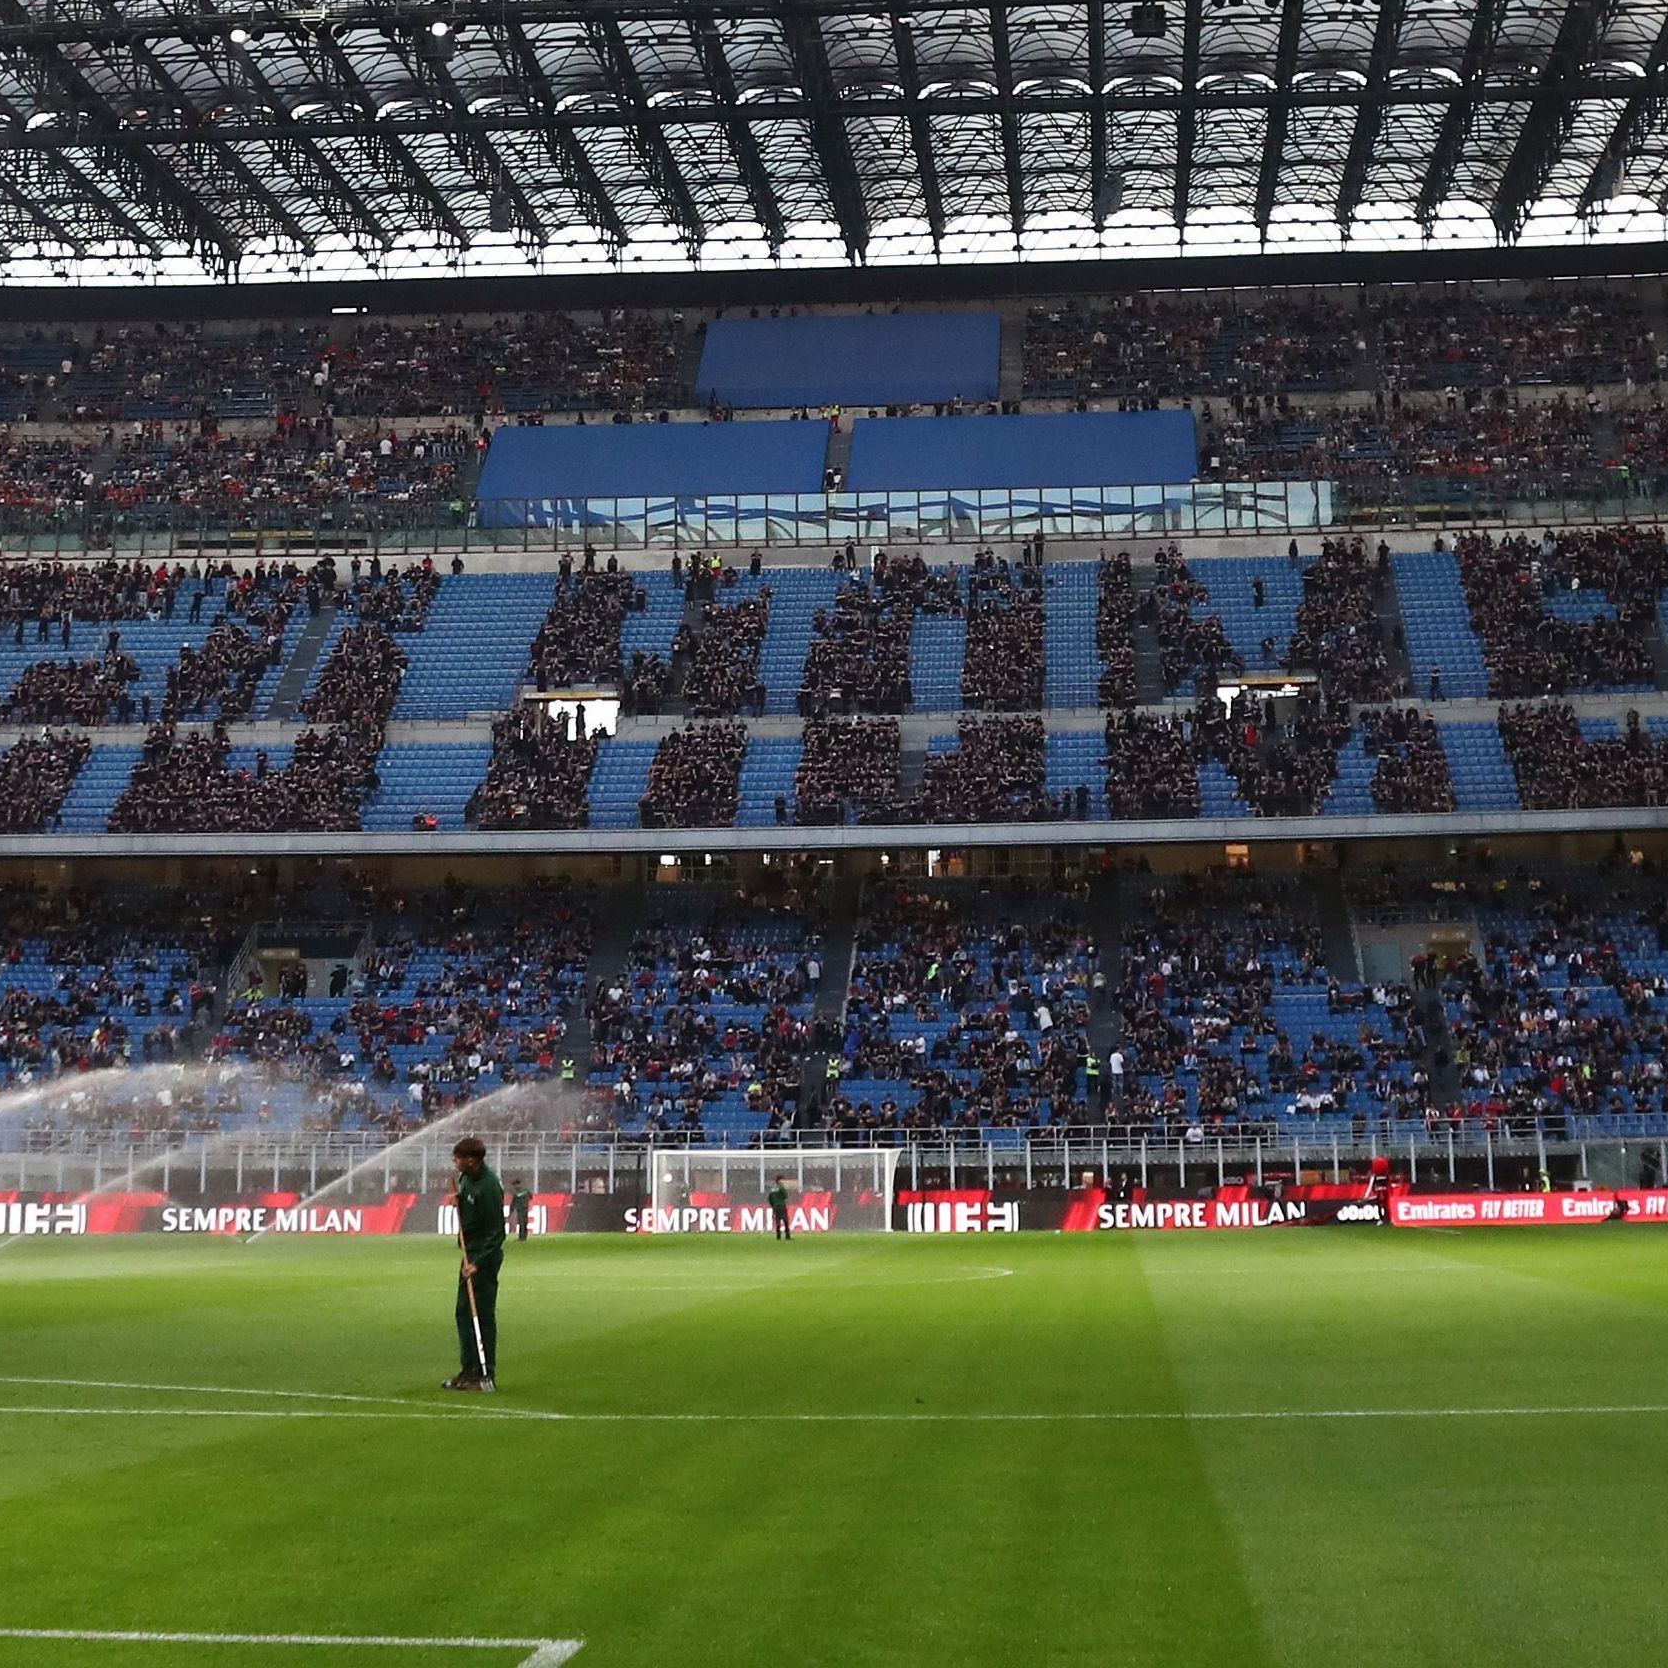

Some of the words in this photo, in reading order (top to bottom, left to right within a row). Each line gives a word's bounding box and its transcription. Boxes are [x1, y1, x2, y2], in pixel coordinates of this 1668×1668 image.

[1098, 1203, 1207, 1229] SEMPRE
[1216, 1201, 1306, 1227] MILAN
[1397, 1201, 1476, 1220] Emirates
[1482, 1200, 1501, 1218] FLY
[1503, 1199, 1545, 1219] BETTER
[1561, 1196, 1641, 1217] Emiras
[162, 1207, 266, 1232] SEMPRE
[275, 1207, 362, 1232] MILAN
[624, 1207, 732, 1232] SEMPRE
